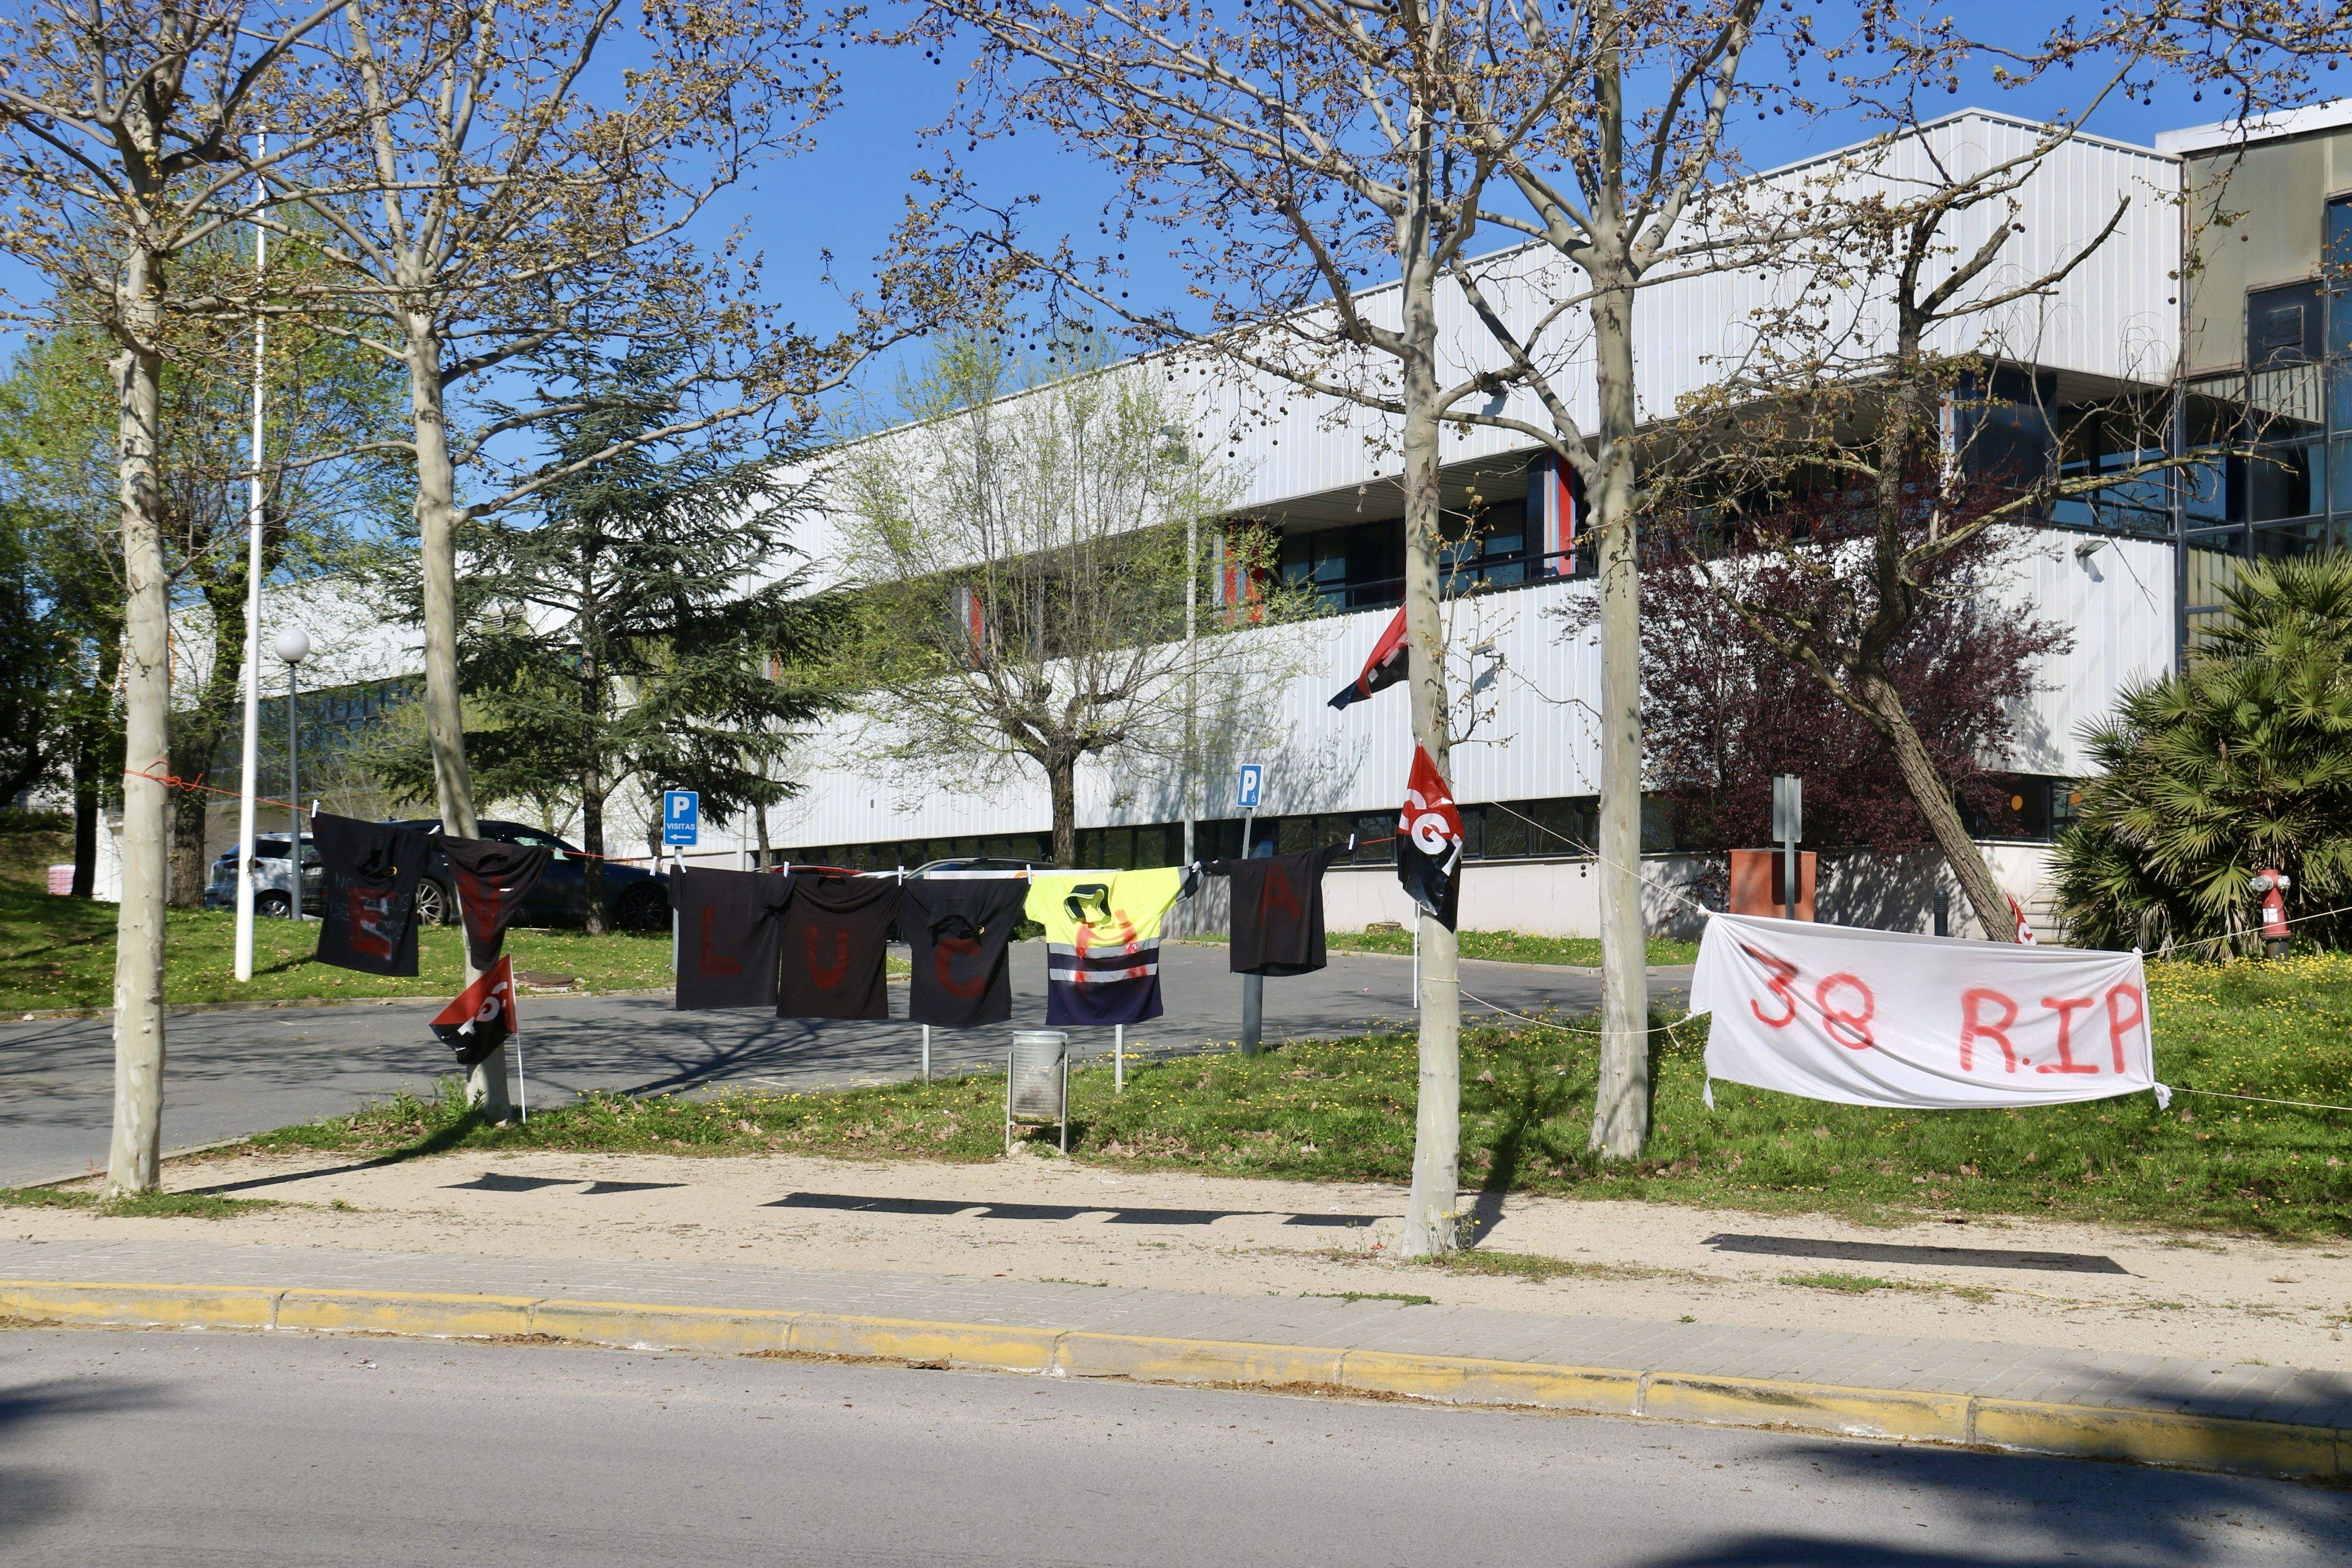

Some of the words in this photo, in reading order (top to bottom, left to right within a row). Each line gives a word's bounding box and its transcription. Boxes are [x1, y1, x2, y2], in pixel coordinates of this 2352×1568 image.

[1242, 770, 1257, 803] P
[673, 796, 690, 819] P
[1738, 939, 1875, 1050] 38
